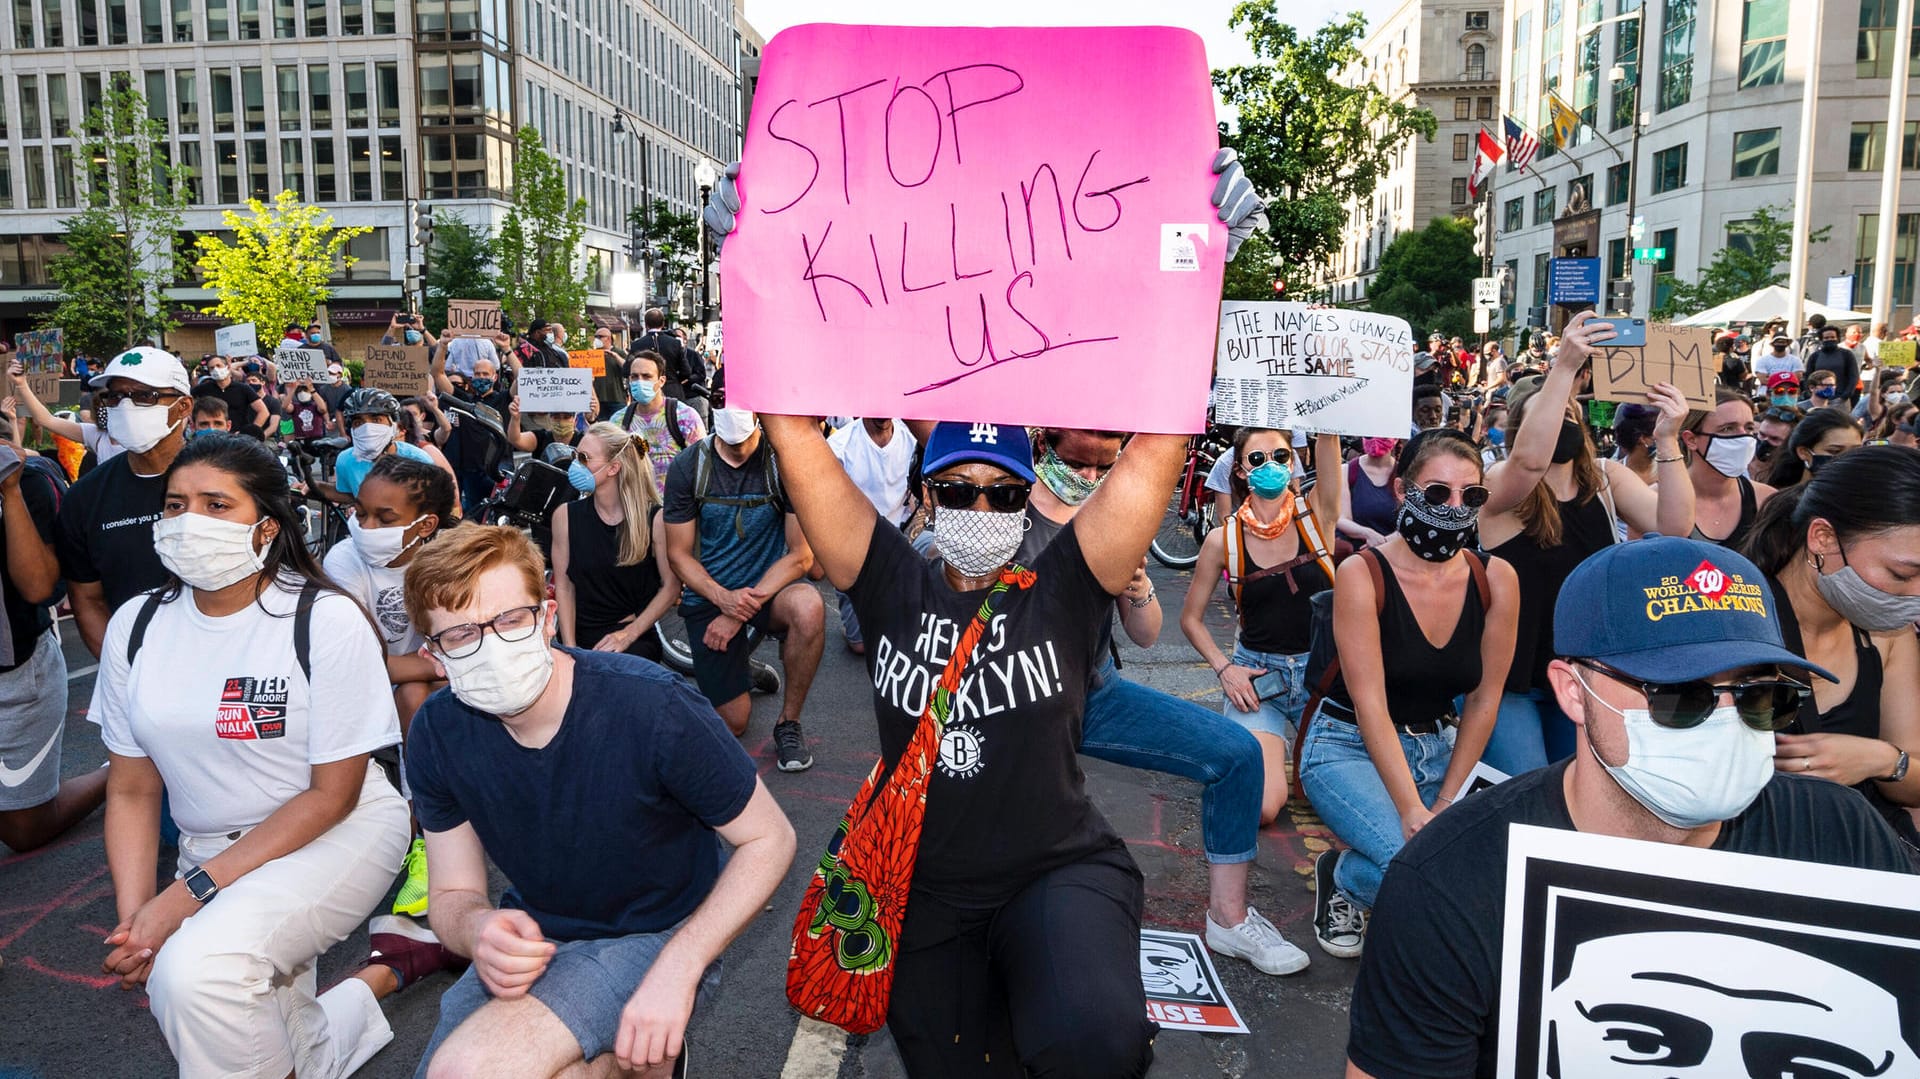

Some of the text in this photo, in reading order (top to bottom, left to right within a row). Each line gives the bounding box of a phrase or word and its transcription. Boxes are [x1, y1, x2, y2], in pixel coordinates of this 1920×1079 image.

[761, 63, 1024, 215] STOP
[802, 149, 1150, 322] KILLING
[450, 308, 501, 330] JUSTICE
[1226, 309, 1409, 346] THE NAMES CHANGE
[279, 351, 311, 362] #END
[367, 345, 406, 360] DEFUND
[1227, 333, 1411, 373] BUT THE COLOR STAYS
[280, 361, 314, 371] WHITE
[368, 369, 399, 379] INVEST
[384, 360, 416, 371] POLICE
[1256, 357, 1356, 377] THE SAME
[283, 370, 328, 382] SILENCE
[519, 376, 547, 387] JAMES
[969, 423, 998, 445] LA
[102, 523, 106, 531] I
[106, 517, 137, 529] consider
[138, 514, 152, 525] you
[1661, 574, 1744, 586] 20 19
[1694, 568, 1723, 594] W
[1643, 583, 1763, 600] WORLD SERIES
[1646, 595, 1767, 622] CHAMPIONS
[255, 676, 288, 694] TED
[253, 693, 286, 702] MOORE
[217, 709, 242, 720] RUN
[216, 721, 252, 733] WALK
[954, 736, 967, 766] B
[936, 761, 985, 780] NEW YORK
